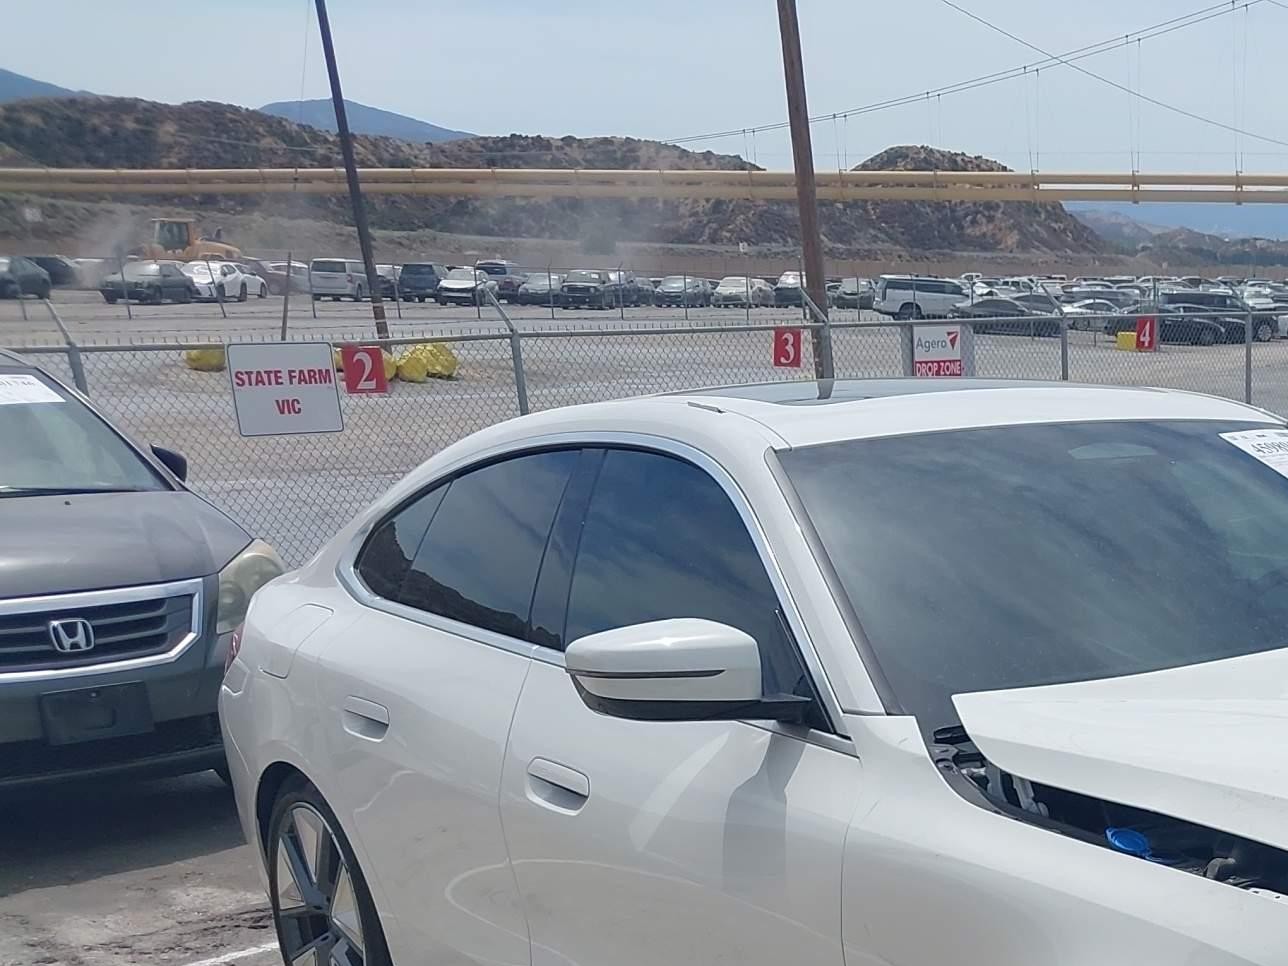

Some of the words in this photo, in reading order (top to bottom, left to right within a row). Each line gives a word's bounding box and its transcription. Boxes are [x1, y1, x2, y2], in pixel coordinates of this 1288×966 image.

[1140, 320, 1150, 347] 4
[779, 332, 795, 364] 3
[916, 336, 947, 352] Agero
[235, 370, 283, 387] STATE
[287, 368, 332, 385] FARM
[352, 351, 377, 390] 2
[916, 362, 938, 376] DROP
[939, 360, 961, 375] ZONE
[275, 398, 302, 415] VIC
